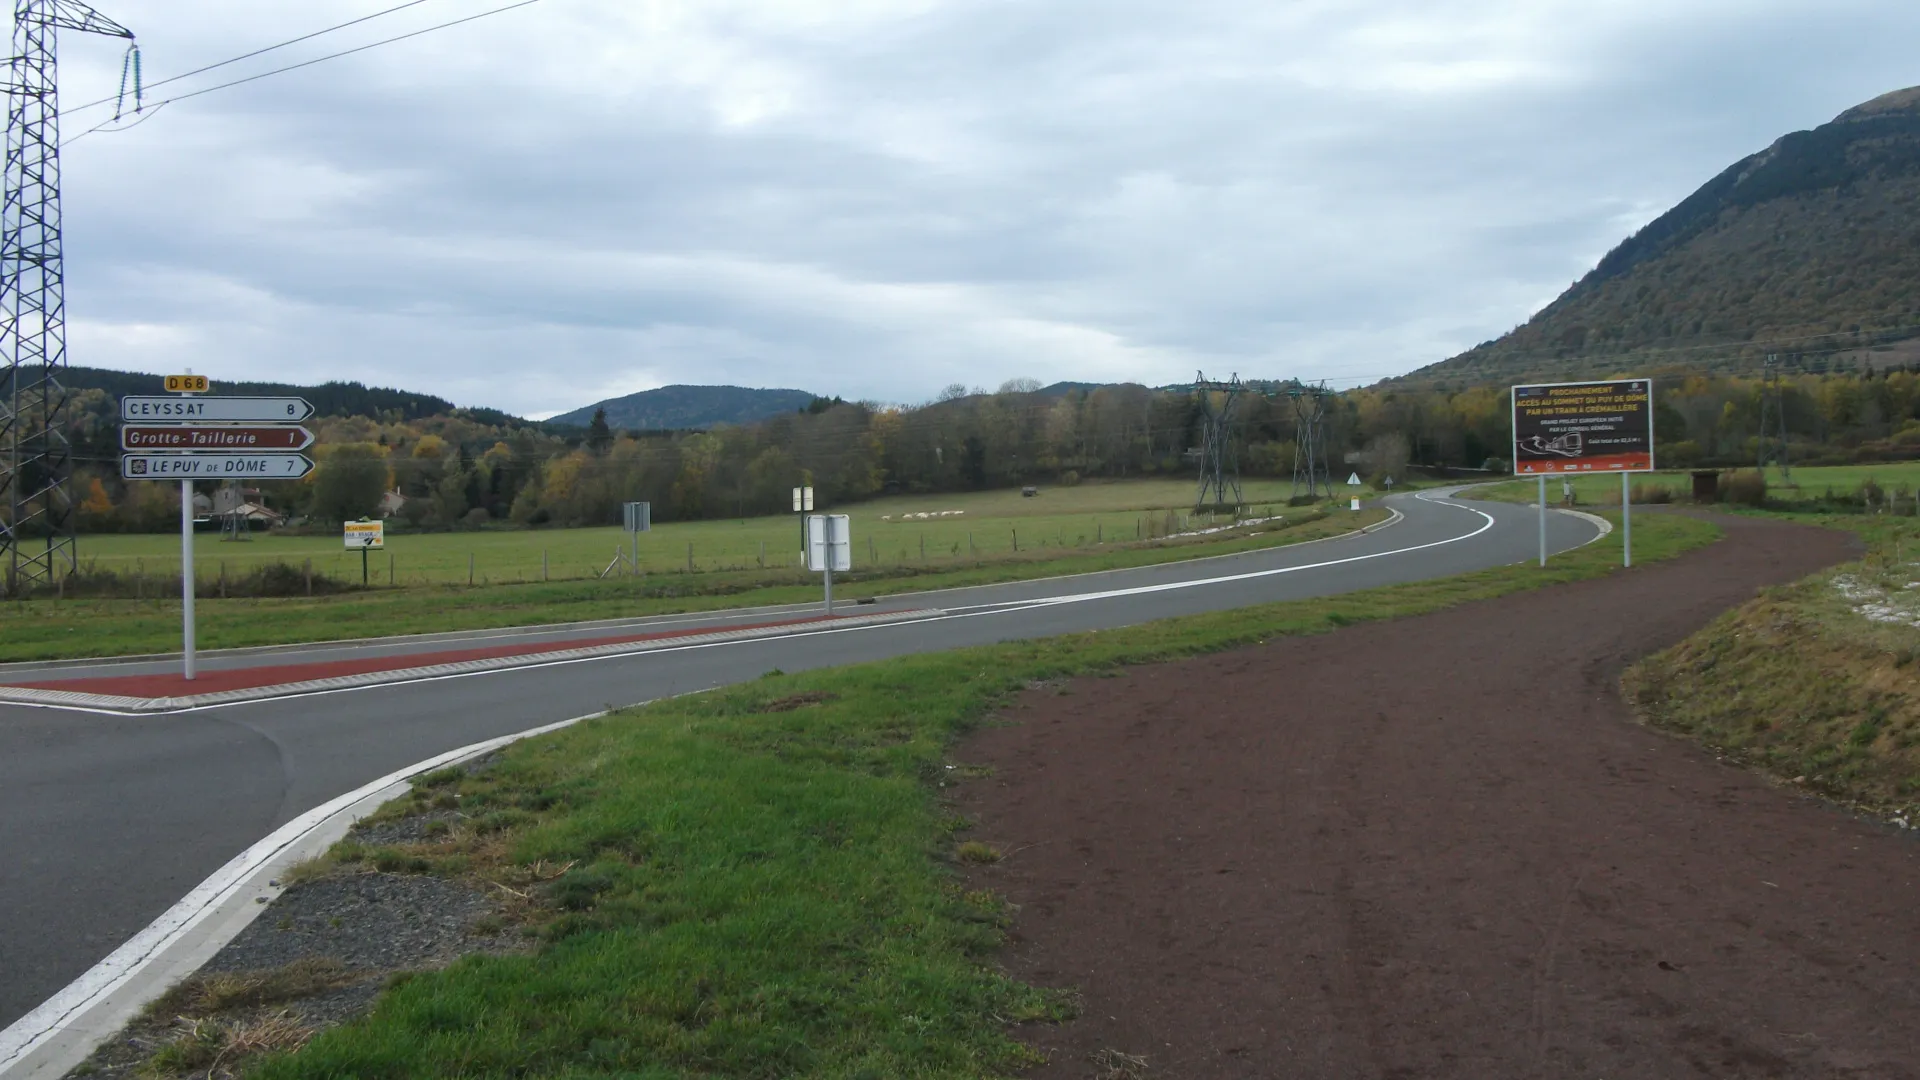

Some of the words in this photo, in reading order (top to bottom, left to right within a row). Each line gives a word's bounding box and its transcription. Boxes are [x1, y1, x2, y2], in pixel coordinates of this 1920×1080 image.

[169, 378, 178, 389] D
[184, 378, 205, 389] 68
[1549, 386, 1613, 396] PROCHAINEMENT
[1516, 398, 1540, 407] ACCÈS
[1553, 397, 1584, 405] SOMMET
[1586, 396, 1597, 404] DU
[1598, 395, 1613, 403] PUY
[1614, 394, 1625, 402] DE
[130, 403, 205, 415] CEYSSAT
[286, 404, 295, 415] 8
[1526, 408, 1542, 416] PAR
[1555, 406, 1577, 415] TRAIN
[130, 431, 257, 444] Grotte-Taillerie
[288, 432, 295, 443] 1
[152, 461, 168, 472] LE
[172, 461, 201, 472] PUY
[225, 458, 268, 472] DÔME
[286, 461, 295, 471] 7
